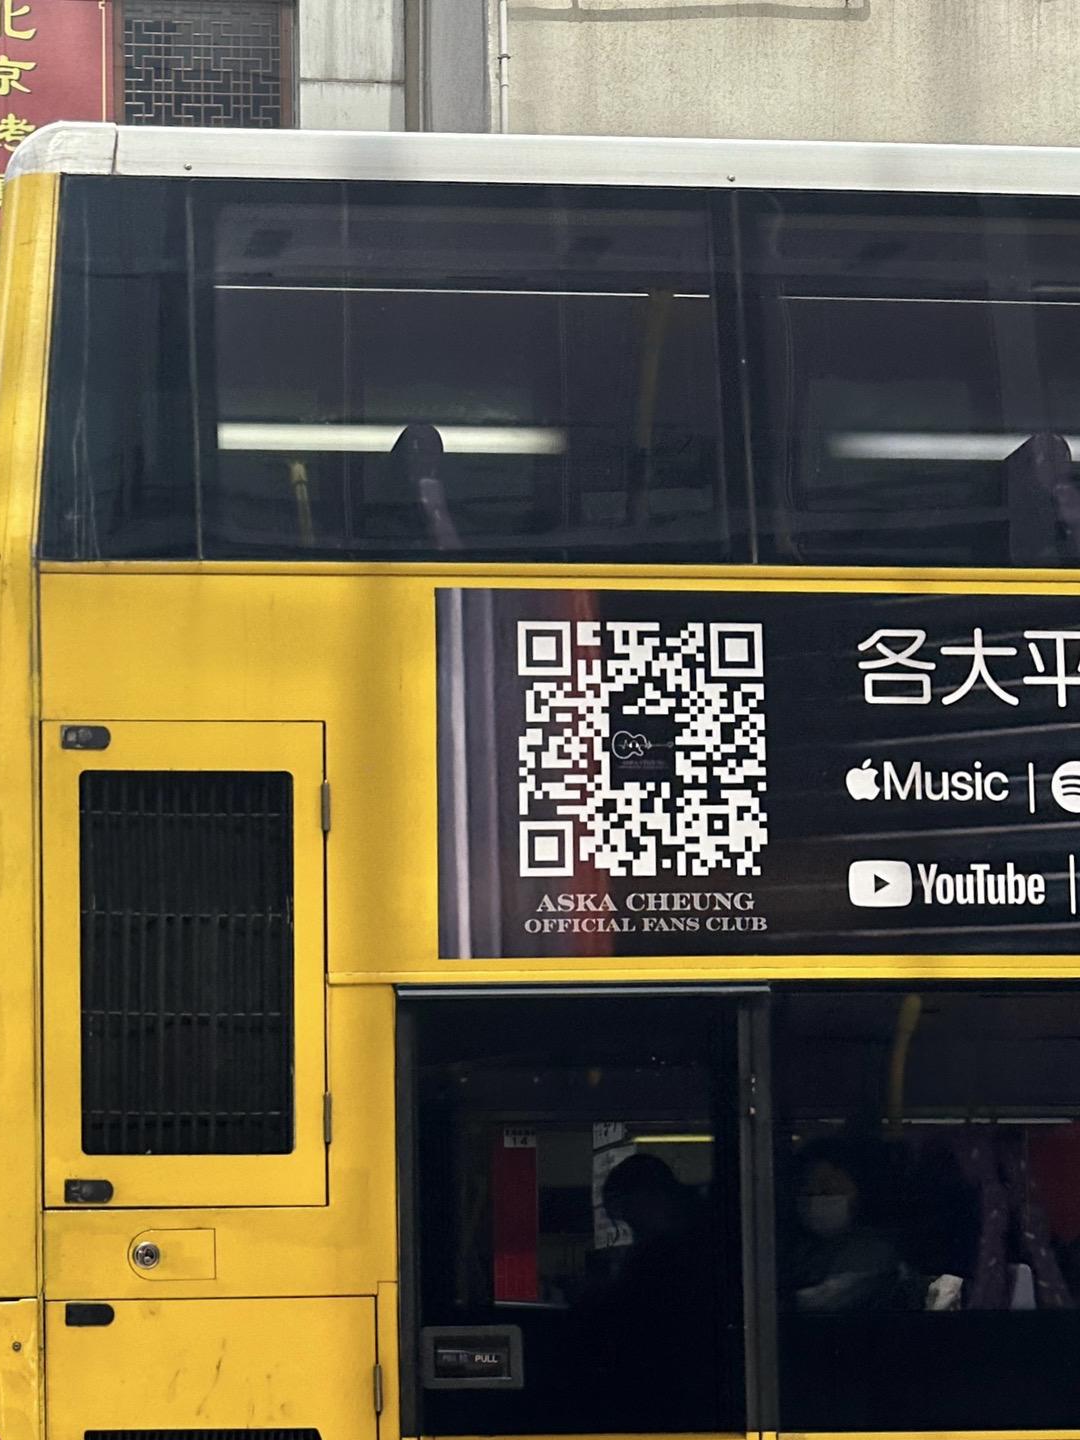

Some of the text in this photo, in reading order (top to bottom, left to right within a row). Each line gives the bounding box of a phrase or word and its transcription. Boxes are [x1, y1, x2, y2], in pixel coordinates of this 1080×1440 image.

[857, 626, 1080, 708] 各大平
[882, 760, 1010, 802] Music
[916, 861, 1046, 905] YouTube
[535, 892, 756, 913] ASKA CHEUNG
[523, 916, 768, 934] OFFICIAL FANS CLUB
[474, 1354, 498, 1363] PULL
